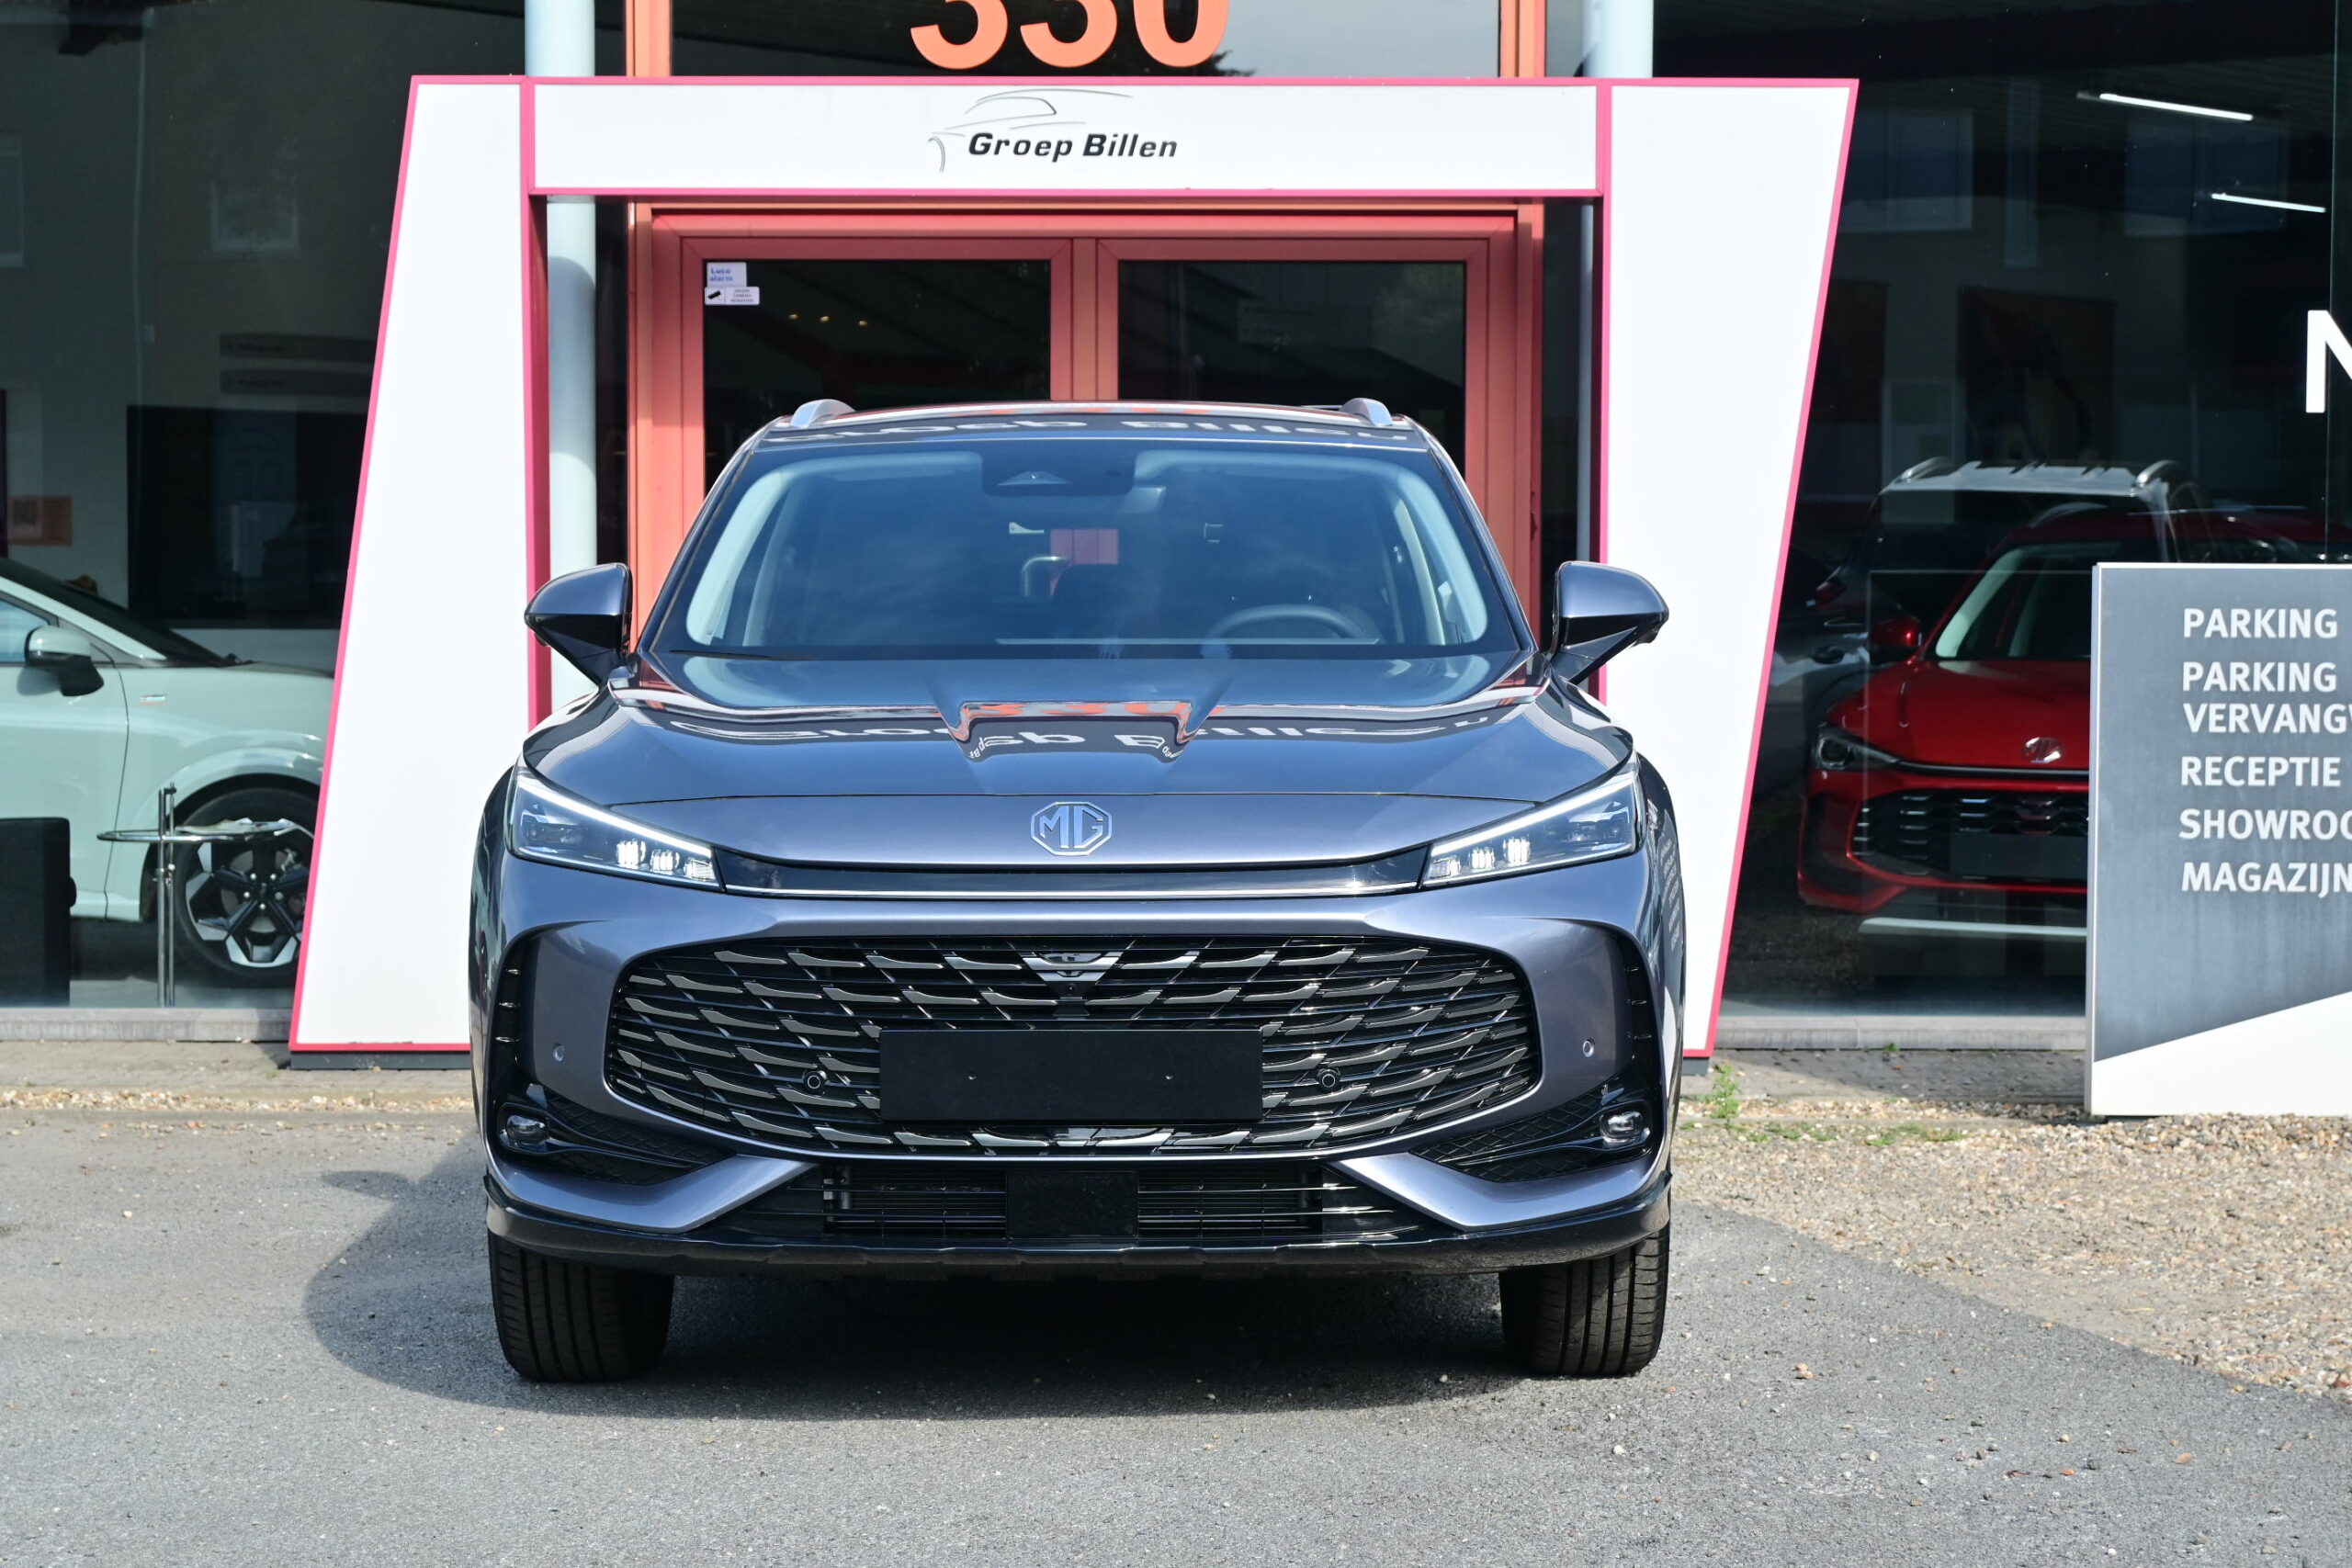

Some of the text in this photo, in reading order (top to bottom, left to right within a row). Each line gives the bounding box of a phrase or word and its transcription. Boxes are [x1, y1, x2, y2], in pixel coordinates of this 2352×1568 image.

[968, 132, 1179, 163] Groep Billen
[2183, 608, 2338, 639] PARKING
[2182, 661, 2337, 693] PARKING
[2183, 703, 2352, 734] VERVANG
[2181, 756, 2341, 787] RECEPTIE
[1037, 804, 1106, 852] MG
